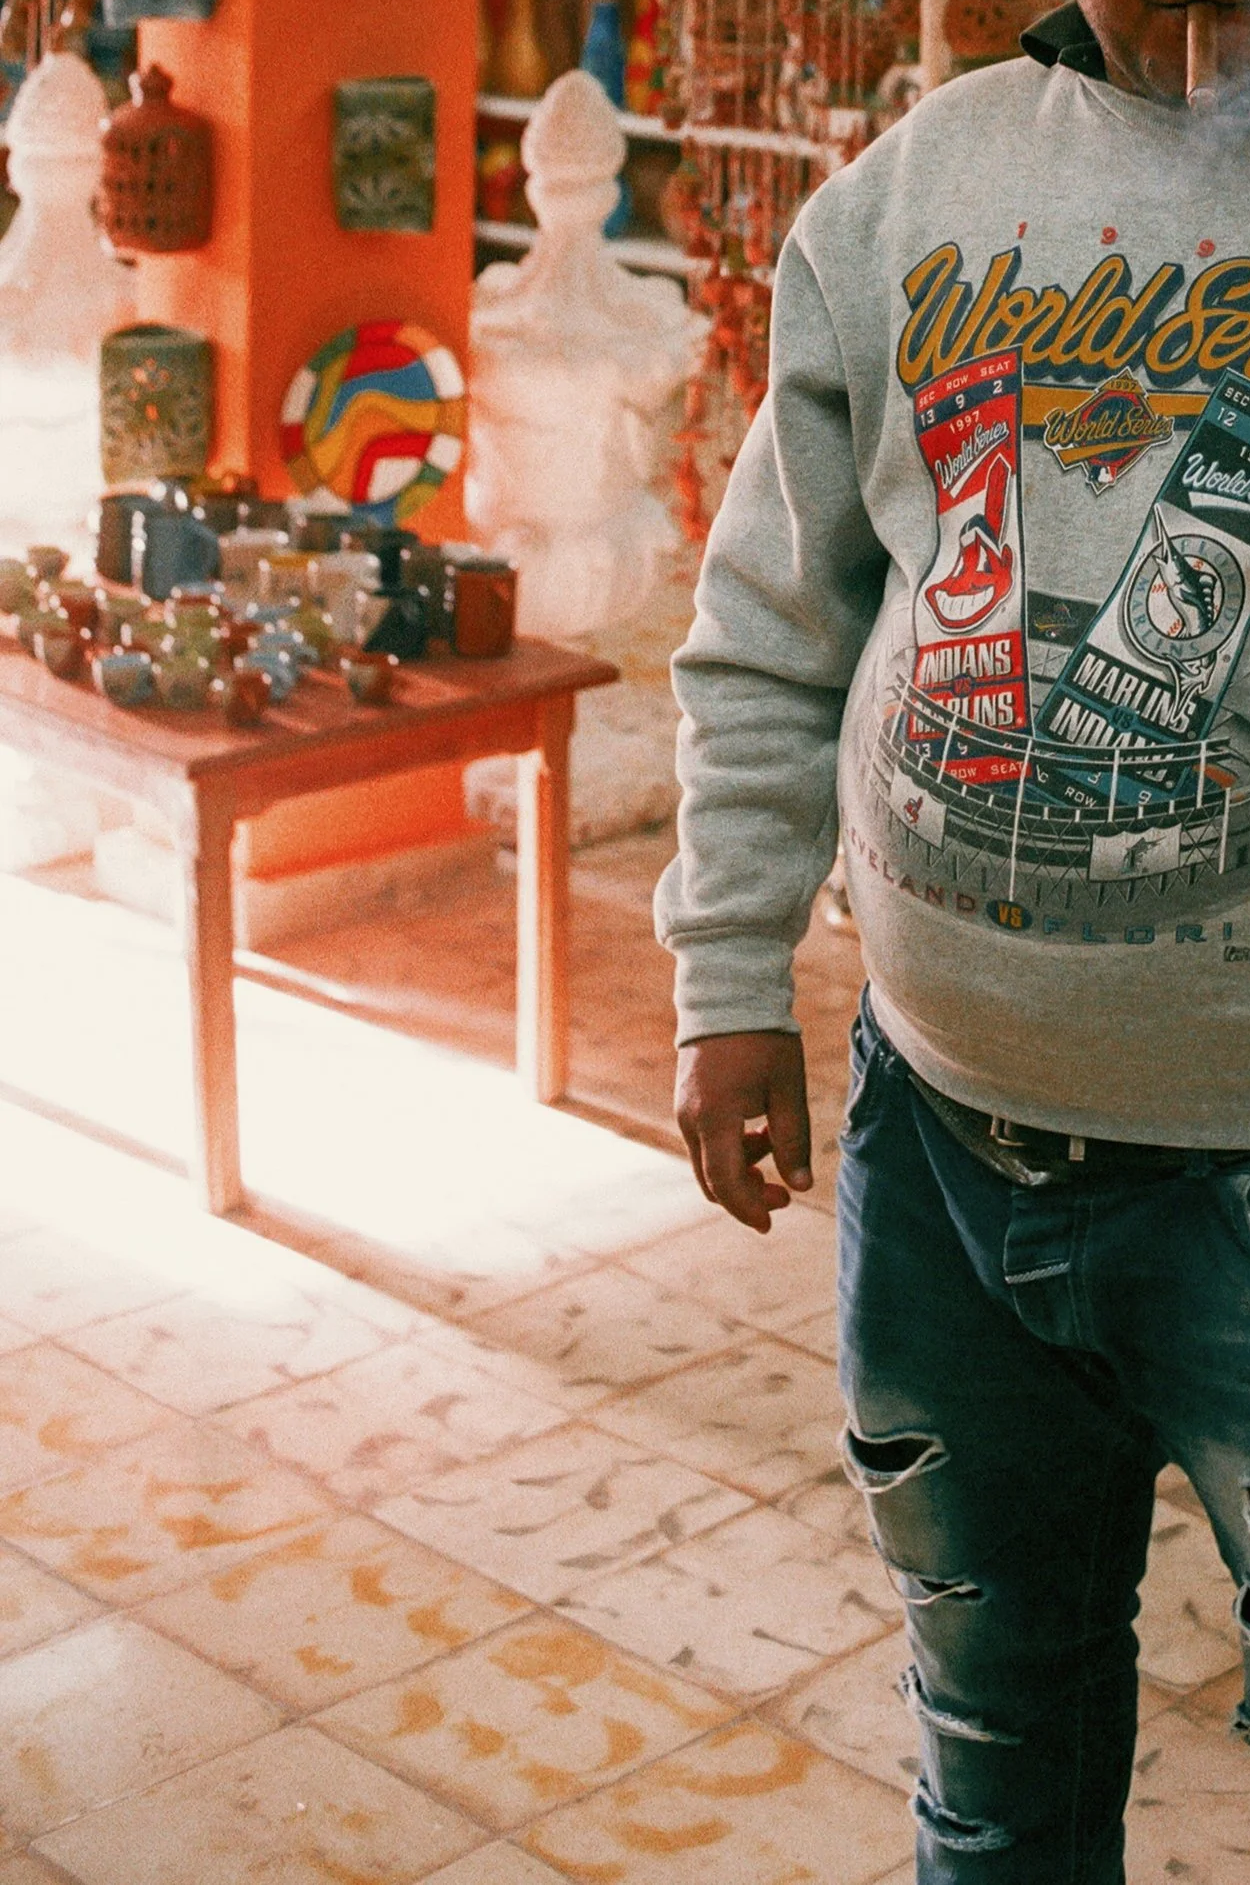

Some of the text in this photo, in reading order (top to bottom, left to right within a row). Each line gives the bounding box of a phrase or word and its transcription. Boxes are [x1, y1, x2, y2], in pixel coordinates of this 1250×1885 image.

[896, 241, 1186, 397] World
[919, 360, 1011, 408] SEC ROW SEAT
[920, 379, 1003, 428] 13 9 2
[1109, 378, 1138, 392] 1997
[1224, 386, 1250, 407] SEC
[949, 409, 981, 435] 1997
[1045, 406, 1173, 445] World Series
[1216, 406, 1238, 428] 12
[934, 420, 1010, 490] World Series
[919, 639, 1012, 686] INDIANS
[1072, 652, 1197, 734] MARLINS
[1064, 786, 1097, 808] ROW
[998, 903, 1022, 929] VS
